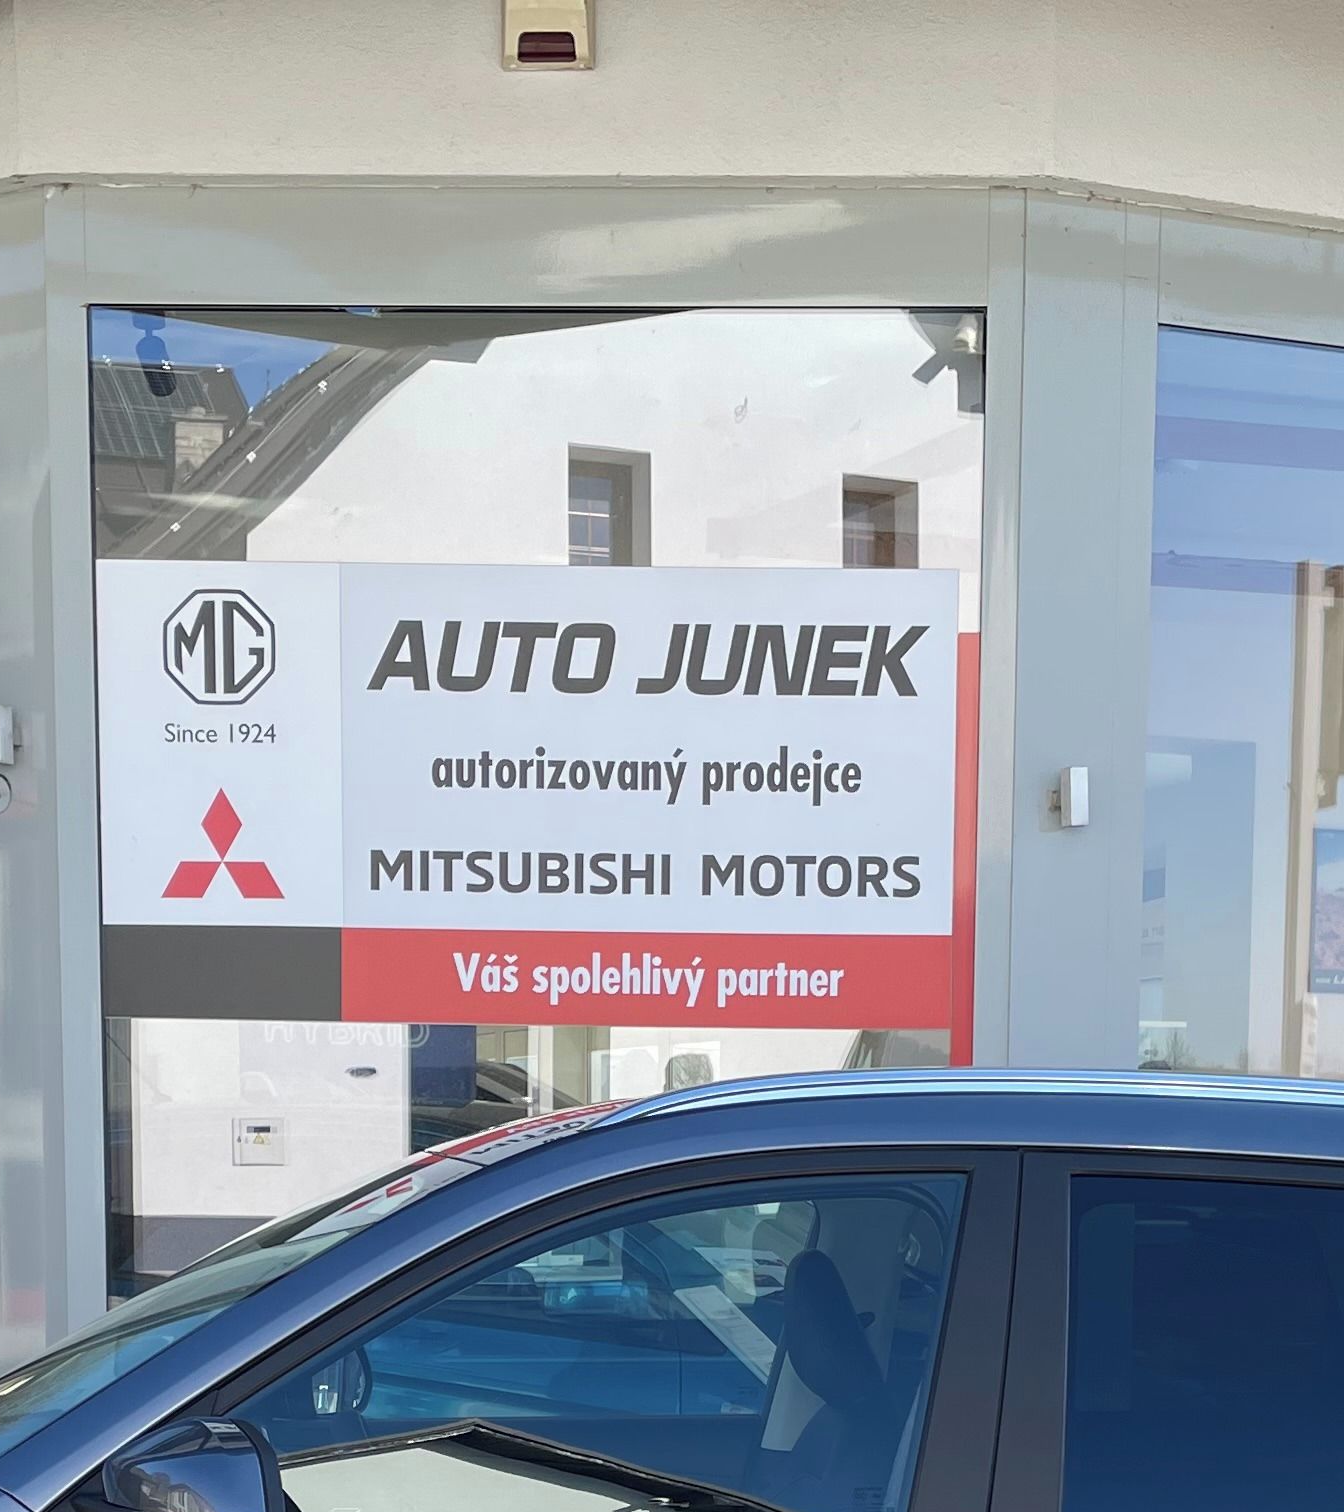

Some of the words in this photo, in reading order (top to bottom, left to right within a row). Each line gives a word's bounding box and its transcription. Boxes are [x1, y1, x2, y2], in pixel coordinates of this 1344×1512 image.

[168, 594, 269, 699] MG
[366, 619, 616, 695] AUTO
[635, 623, 931, 697] JUNEK
[164, 722, 218, 743] Since
[229, 722, 277, 744] 1924
[431, 746, 688, 805] autorizovaný
[702, 745, 862, 807] prodejce
[370, 849, 671, 897] MITSUBISHI
[701, 854, 922, 898] MOTORS
[452, 951, 519, 993] Váš
[531, 951, 706, 1008] spolehlivý
[717, 962, 845, 1009] partner
